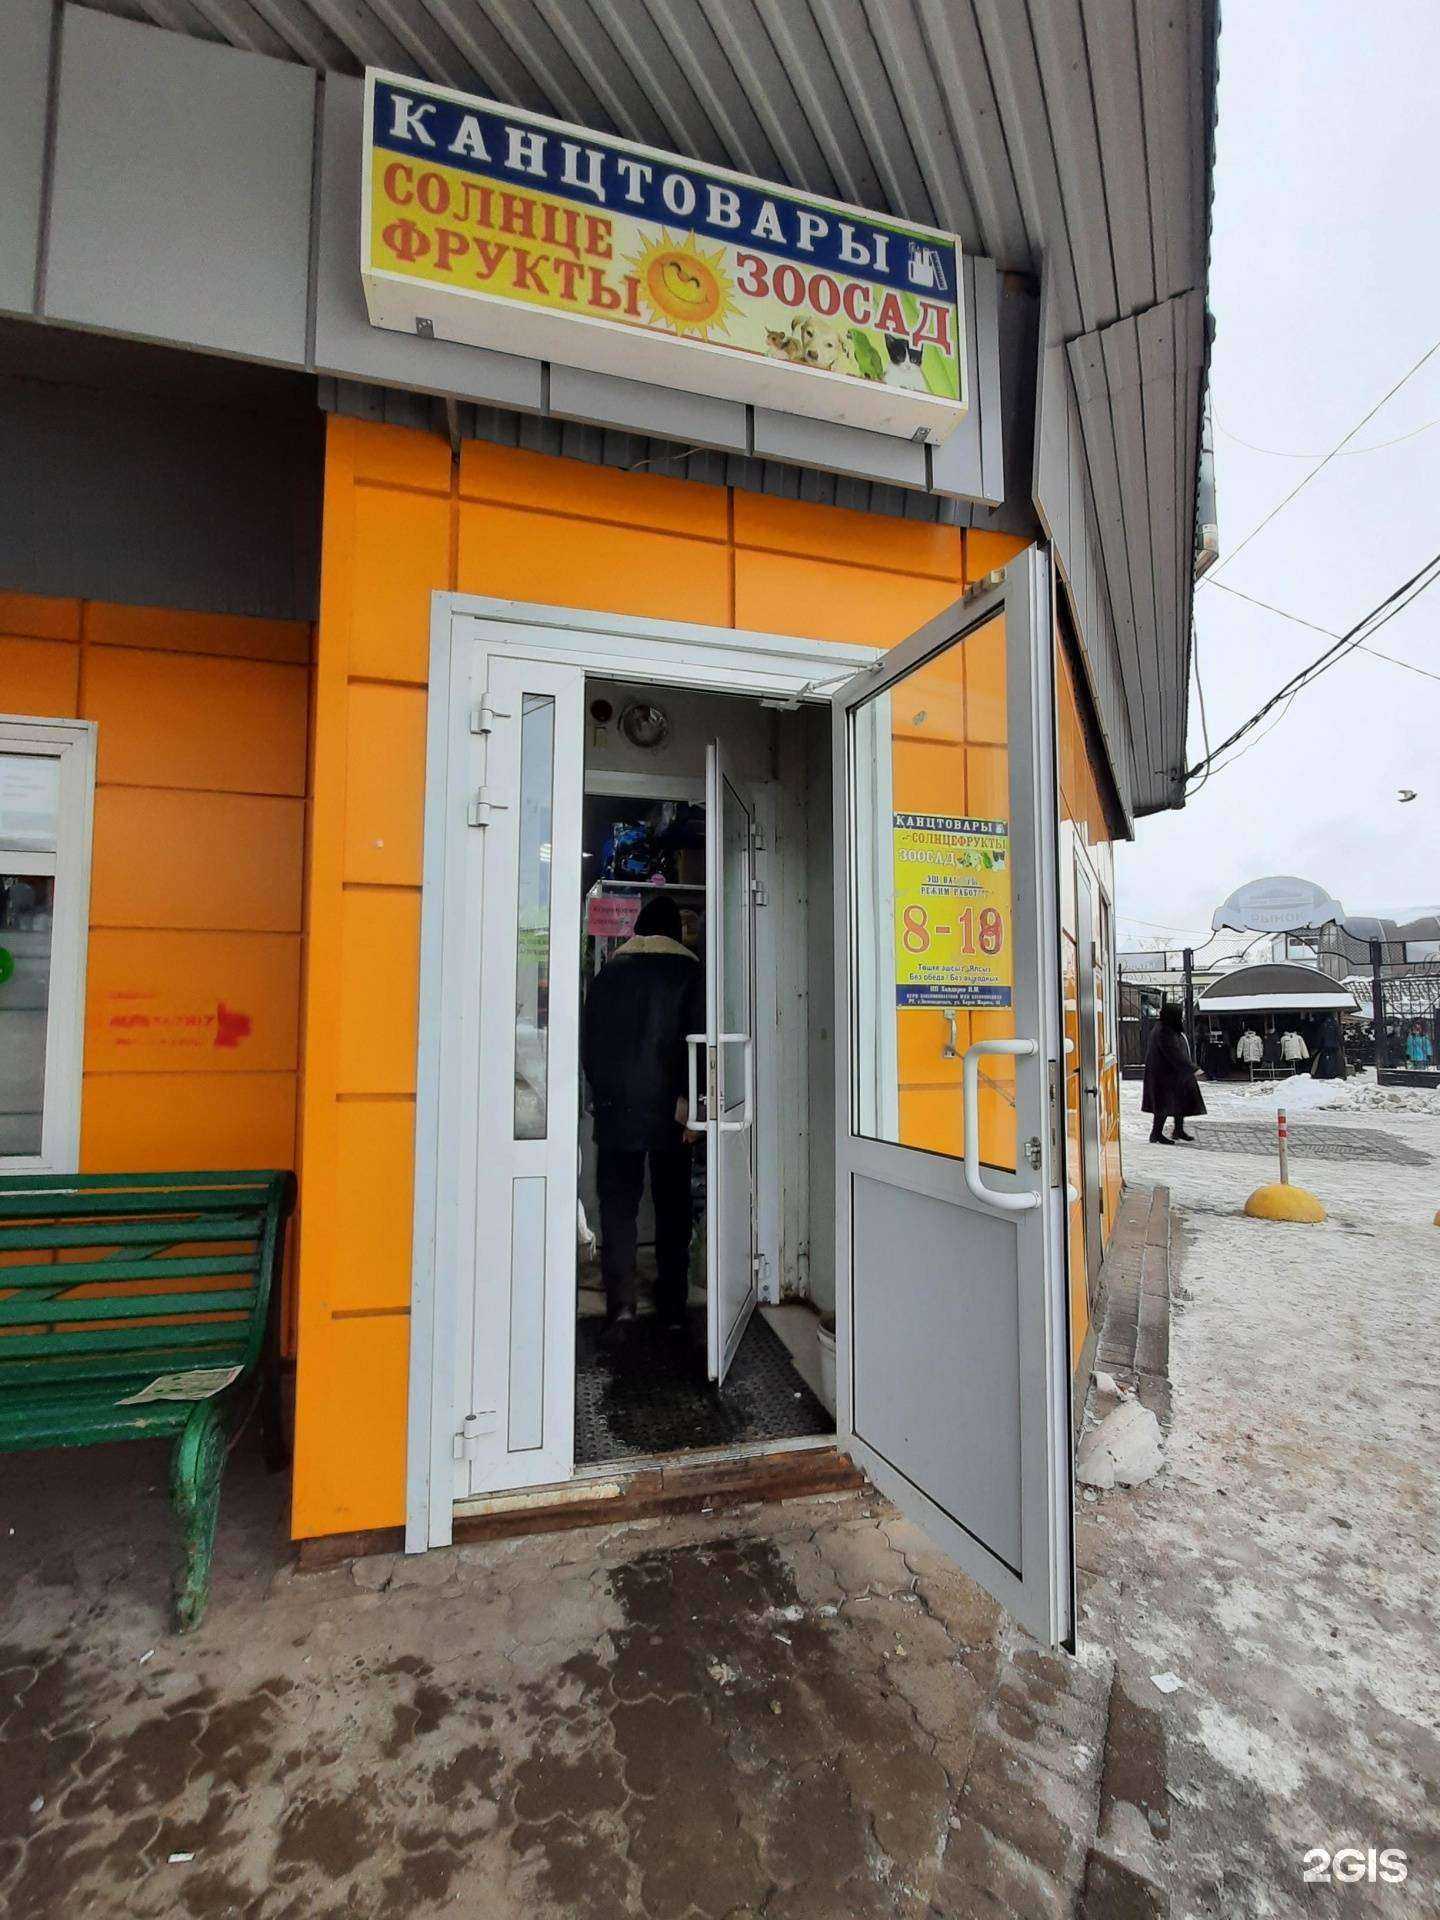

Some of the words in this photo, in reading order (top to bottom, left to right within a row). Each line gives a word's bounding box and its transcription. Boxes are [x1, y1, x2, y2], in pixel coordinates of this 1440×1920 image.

[383, 162, 615, 262] СОЛНЦЕ
[389, 94, 891, 273] КАНЦТОВАРЫ
[382, 217, 641, 317] ФРУКТЫ
[737, 250, 952, 354] ЗООСАД
[896, 815, 993, 832] КАНЦТОВАРЫ
[899, 848, 956, 867] ЗООСАД
[921, 886, 950, 896] РЕЖИМ
